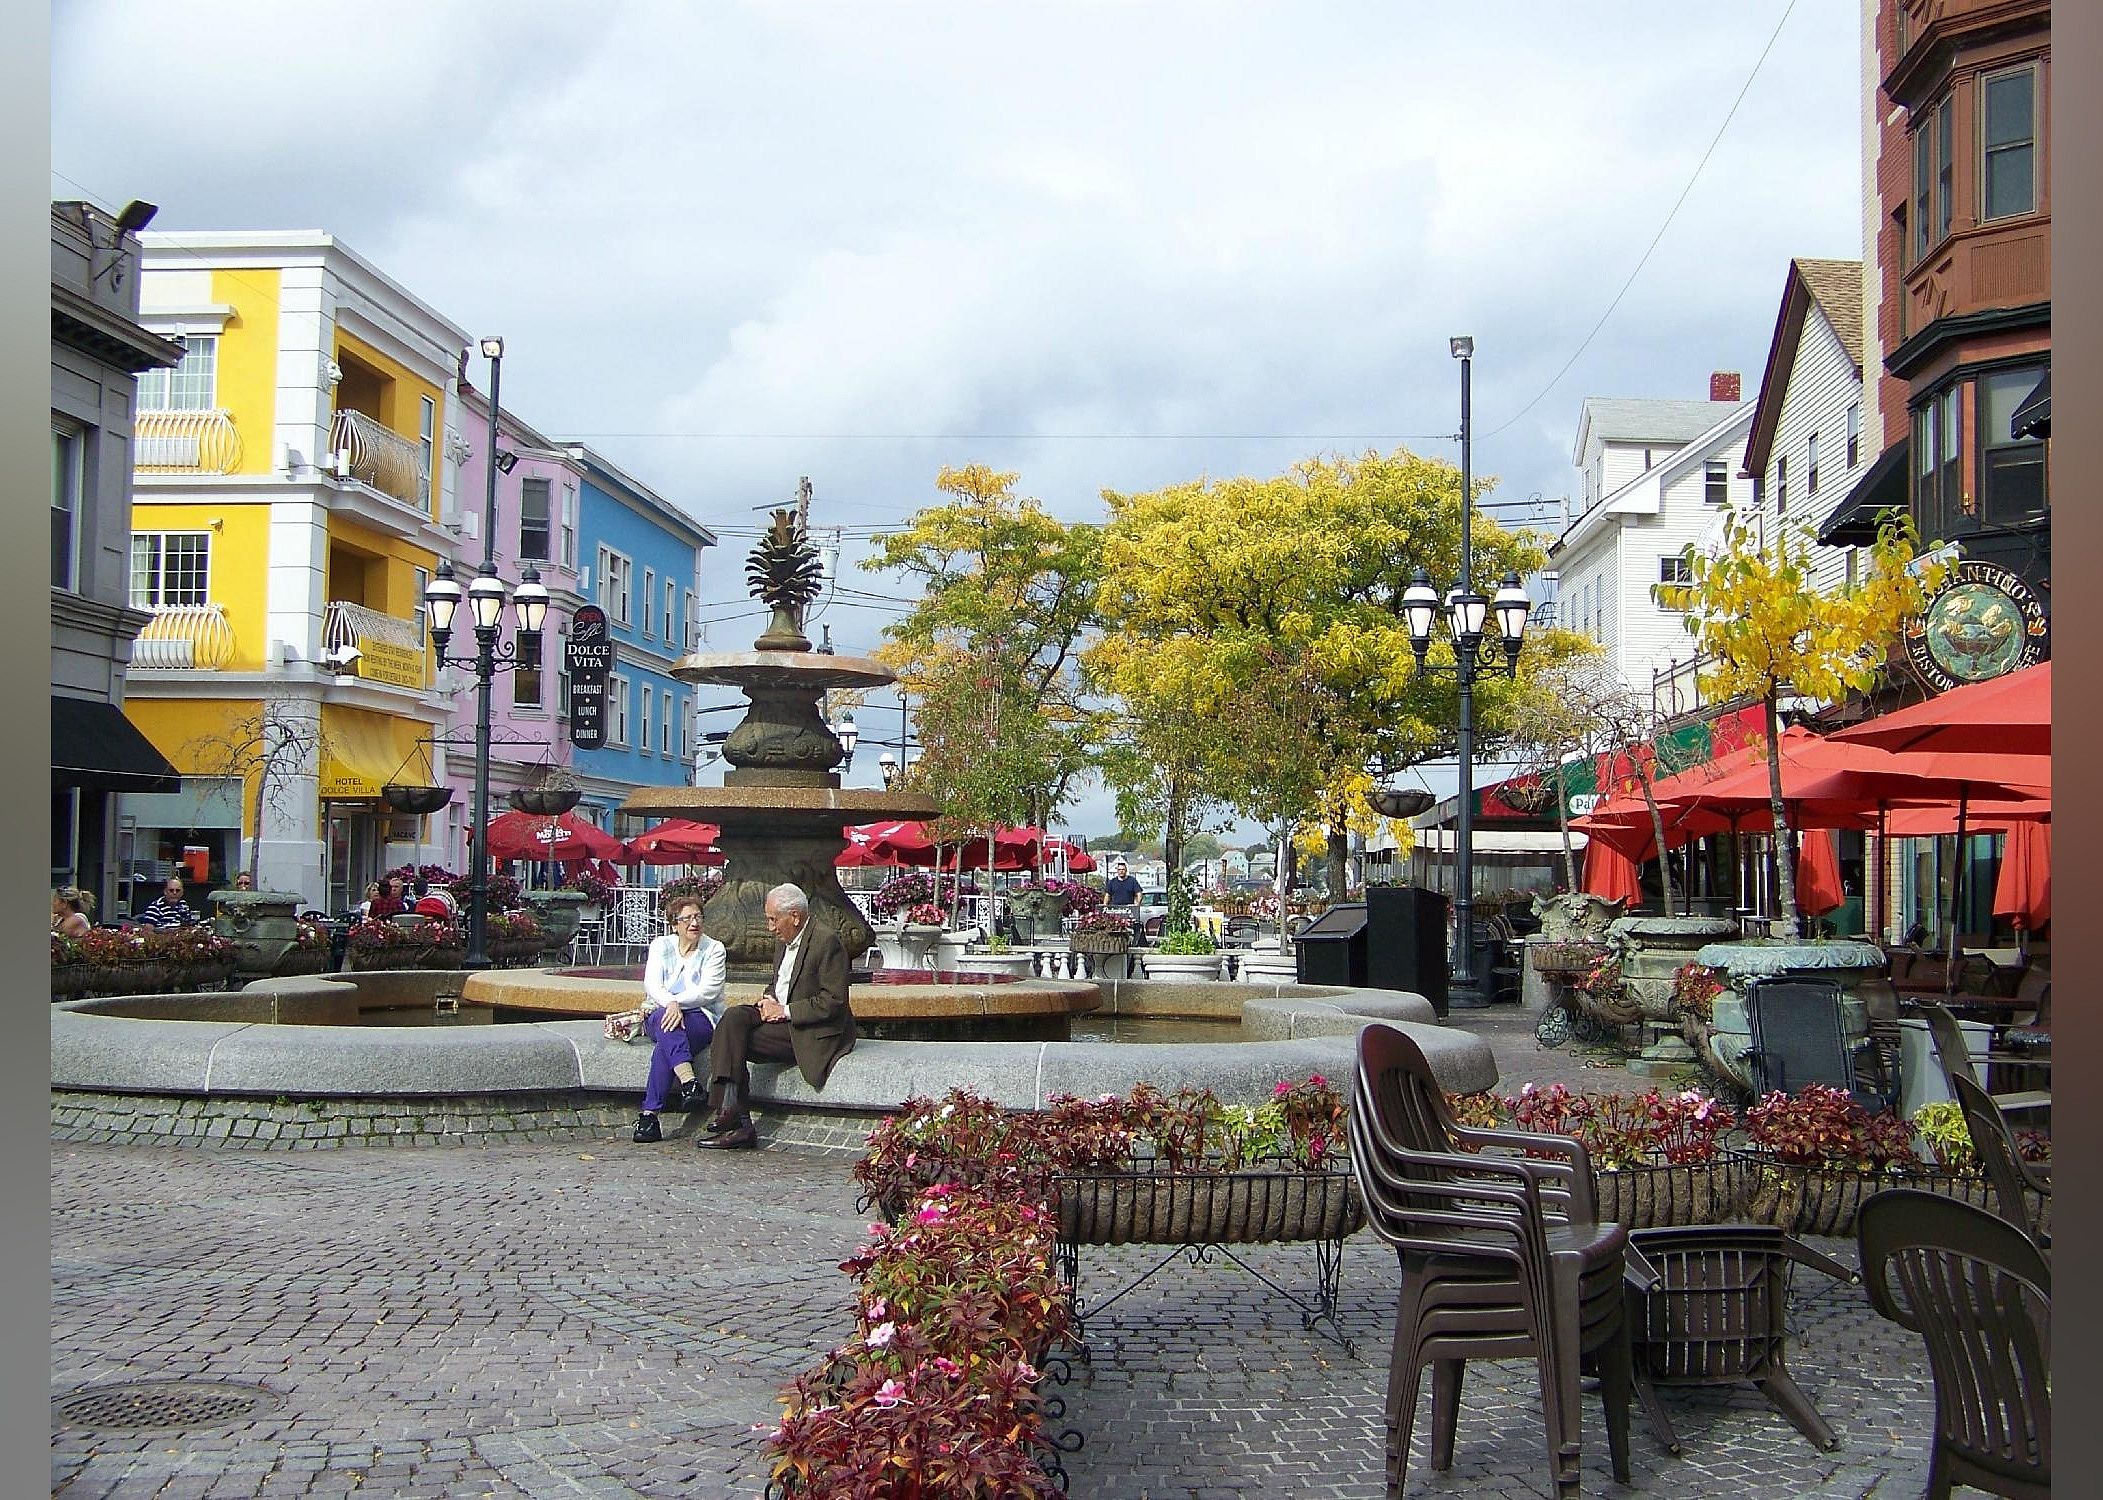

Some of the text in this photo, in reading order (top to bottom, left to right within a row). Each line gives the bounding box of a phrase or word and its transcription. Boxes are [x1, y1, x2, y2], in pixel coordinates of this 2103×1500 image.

[568, 644, 610, 656] DOLCE
[573, 656, 604, 668] VITA
[1911, 644, 1955, 691] RISTOR
[572, 684, 602, 695] BREAKFAST
[578, 706, 597, 717] LUNCH
[575, 729, 598, 739] DINNER
[335, 777, 363, 785] HOTEL
[321, 786, 376, 794] DOLCE VILLA
